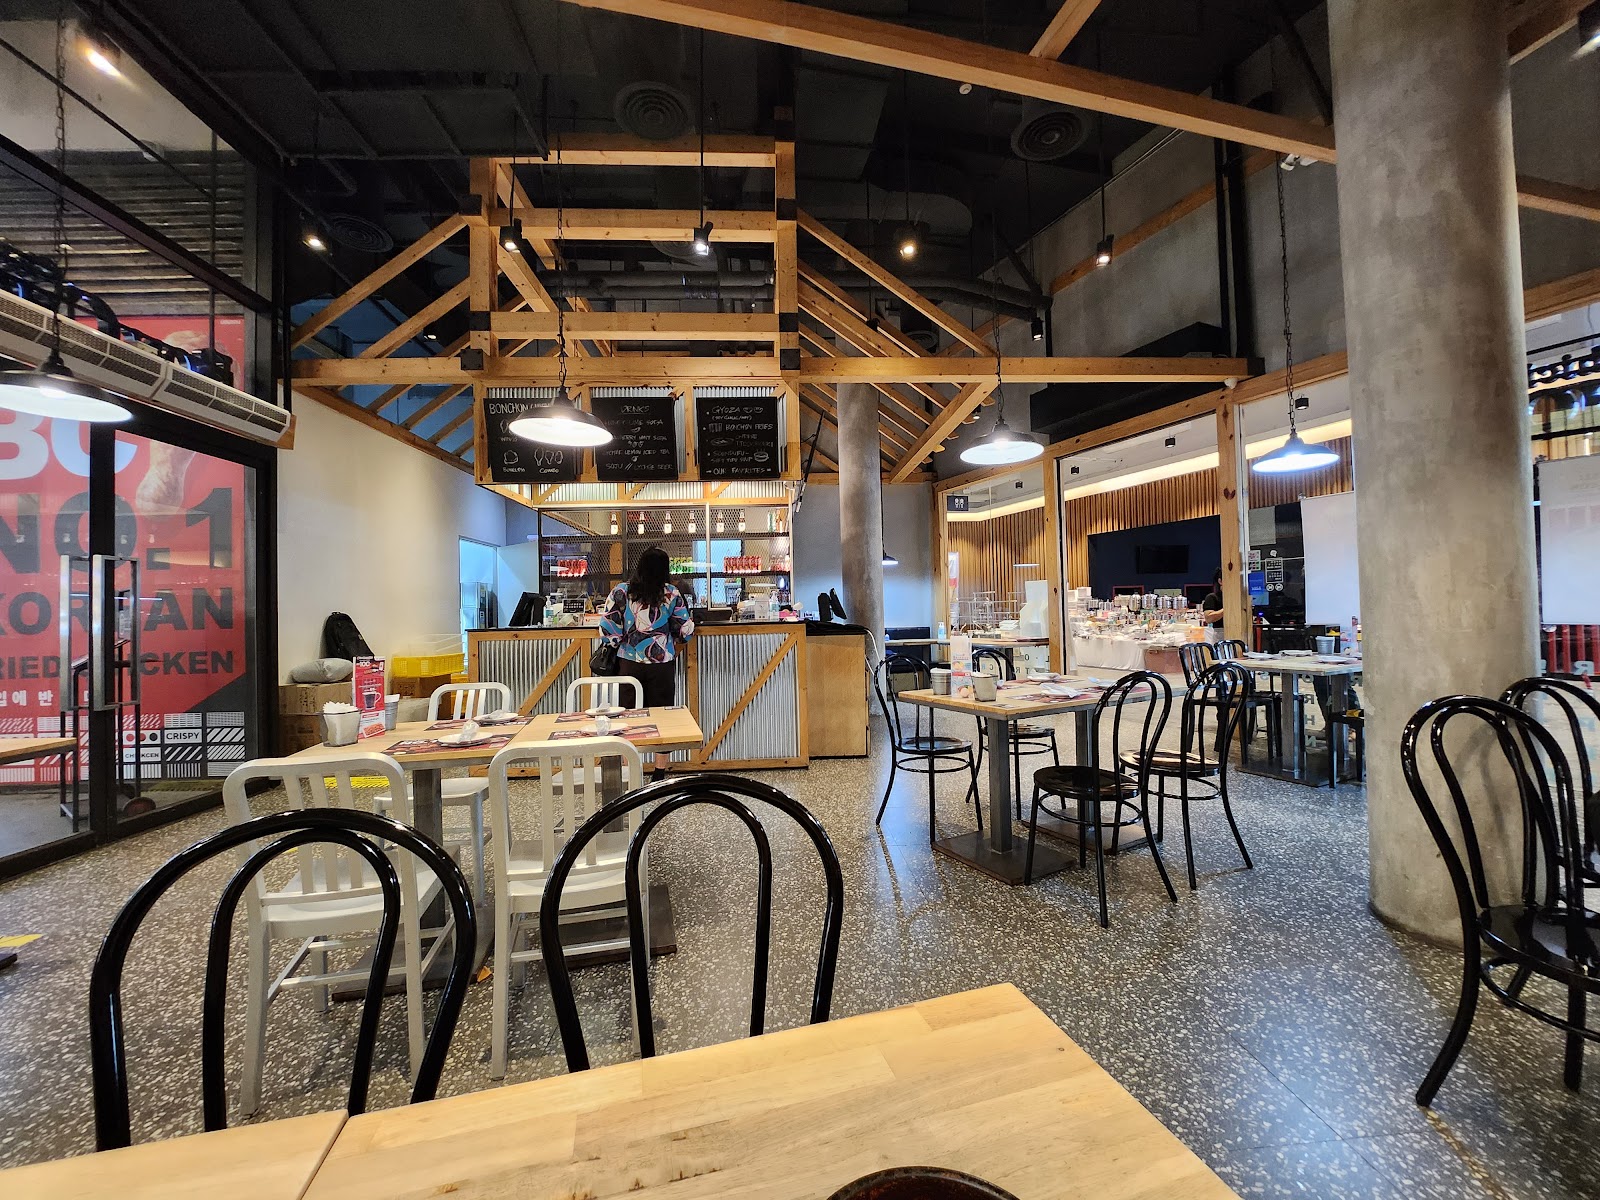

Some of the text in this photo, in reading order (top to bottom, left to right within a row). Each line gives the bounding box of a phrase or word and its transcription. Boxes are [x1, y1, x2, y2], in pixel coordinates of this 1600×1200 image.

[489, 403, 528, 414] BONCHON
[712, 405, 741, 414] GYOZA
[0, 587, 234, 637] ORAN
[0, 650, 235, 681] IED CKEN
[166, 732, 199, 740] CRISPY
